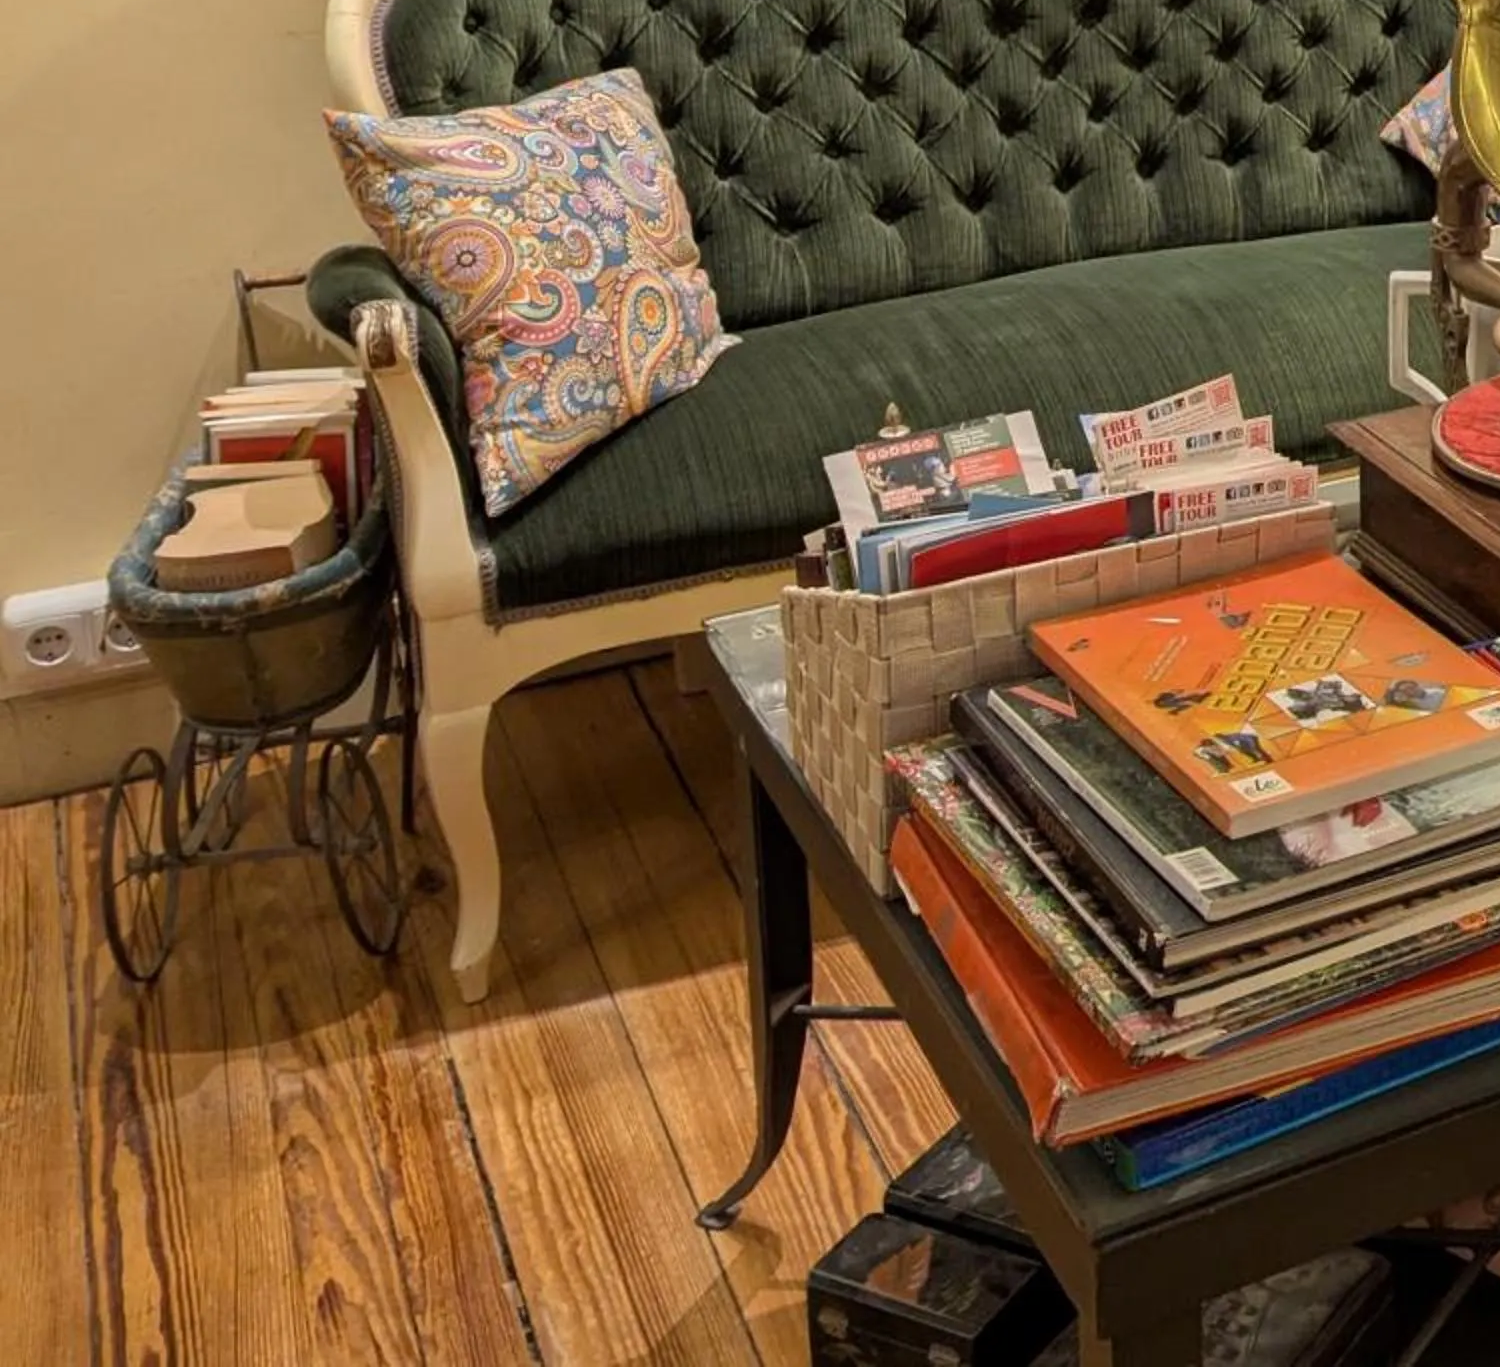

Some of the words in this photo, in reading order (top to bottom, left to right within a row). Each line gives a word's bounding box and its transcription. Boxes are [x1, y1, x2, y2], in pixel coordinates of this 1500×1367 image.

[1101, 415, 1139, 438] FREE
[1106, 428, 1142, 451] TOUR
[1140, 439, 1176, 458] FREE
[1178, 491, 1217, 509] FREE
[1179, 505, 1217, 522] TOUR
